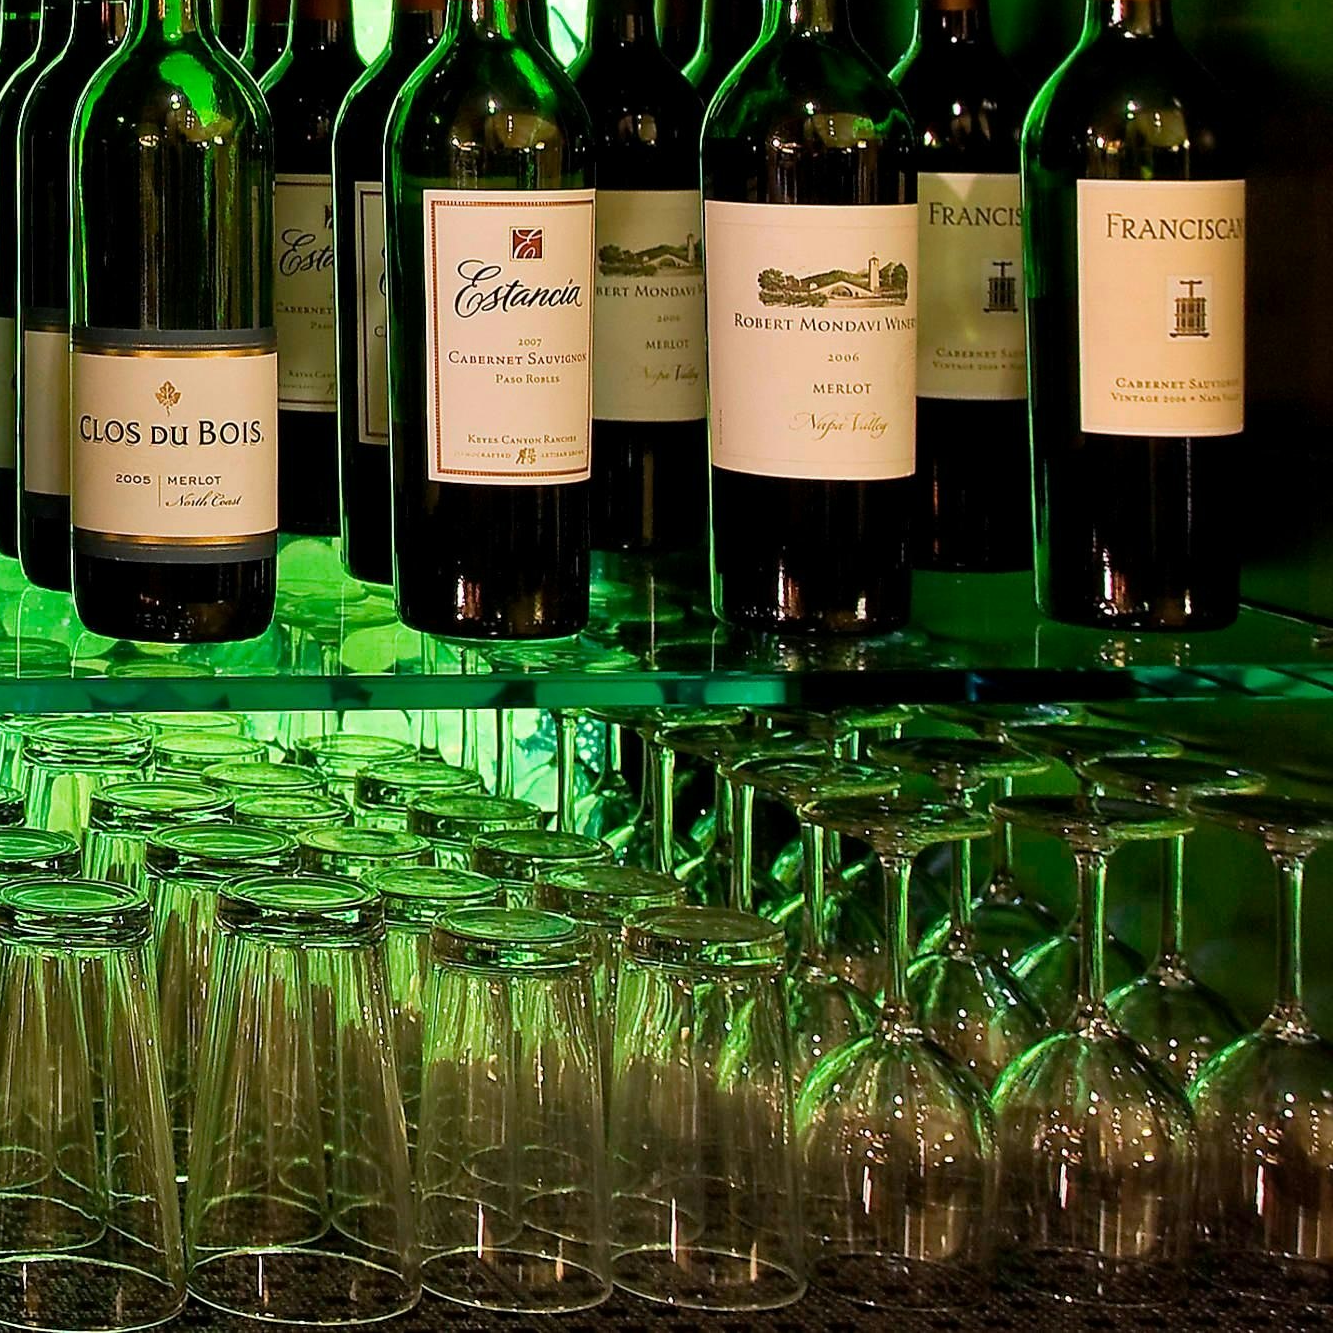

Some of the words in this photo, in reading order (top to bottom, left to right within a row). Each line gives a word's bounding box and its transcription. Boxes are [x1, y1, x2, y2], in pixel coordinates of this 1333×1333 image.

[454, 259, 583, 319] Estancia
[733, 313, 793, 332] ROBERT
[800, 317, 881, 333] MONDAVI
[518, 338, 542, 347] 2007
[645, 339, 689, 350] MERLOT
[448, 350, 523, 366] CABERNET
[528, 351, 587, 366] SAUVIGNON
[828, 353, 860, 363] 2006
[495, 373, 523, 384] PASO
[526, 374, 560, 384] ROBLES
[1115, 378, 1185, 389] CABERNET
[812, 383, 872, 395] MERLOT
[1111, 392, 1158, 402] VINTAGE
[79, 415, 142, 446] CLOS
[789, 411, 845, 441] Napa
[115, 473, 152, 486] 2005
[167, 475, 222, 486] MERLOT
[164, 493, 210, 508] North
[211, 493, 242, 508] Coast
